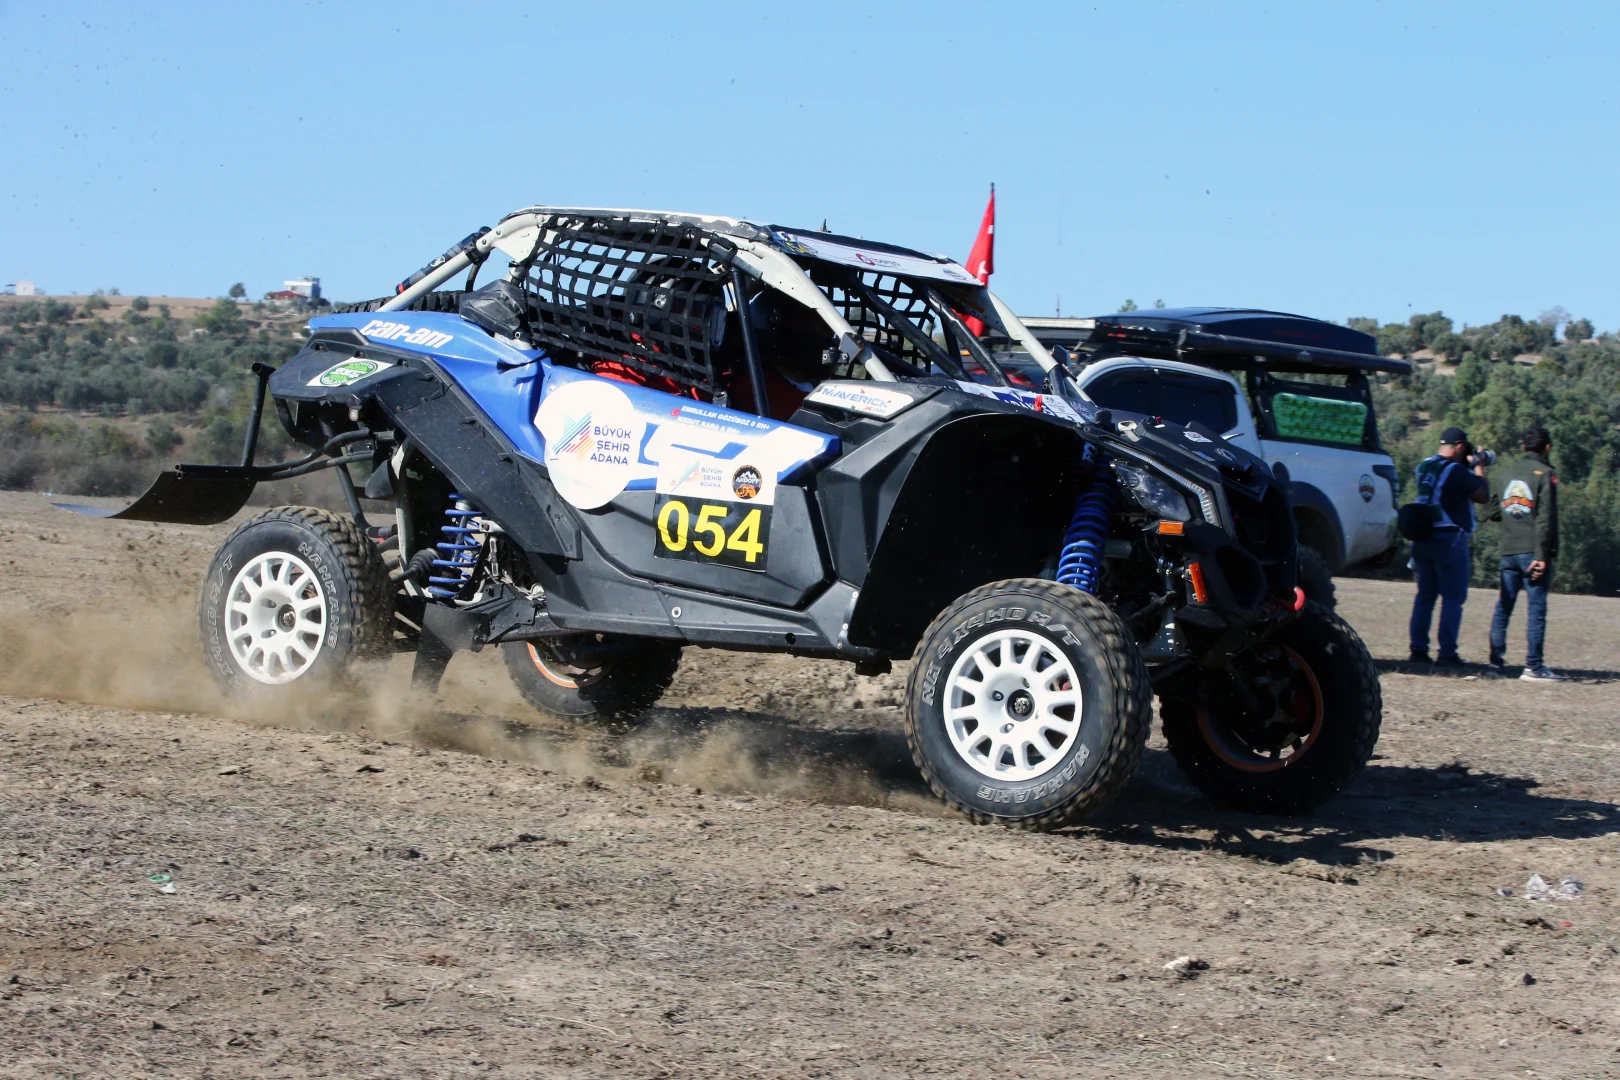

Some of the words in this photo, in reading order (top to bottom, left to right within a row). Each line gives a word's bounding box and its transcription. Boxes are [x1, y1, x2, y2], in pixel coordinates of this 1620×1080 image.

[359, 319, 454, 349] can-am
[821, 387, 889, 408] MAVERICK
[681, 405, 717, 419] EMRULLAH
[756, 421, 771, 431] RH+
[593, 425, 632, 440] BÜYÜK
[596, 440, 630, 453] ŞEHİR
[589, 452, 629, 466] ADANA
[701, 466, 723, 475] BÜYÜK
[699, 481, 722, 489] ADANA
[657, 500, 764, 563] 054
[298, 540, 340, 650] NANKANG
[1026, 610, 1083, 647] M/T
[976, 743, 1091, 804] NANKANG
